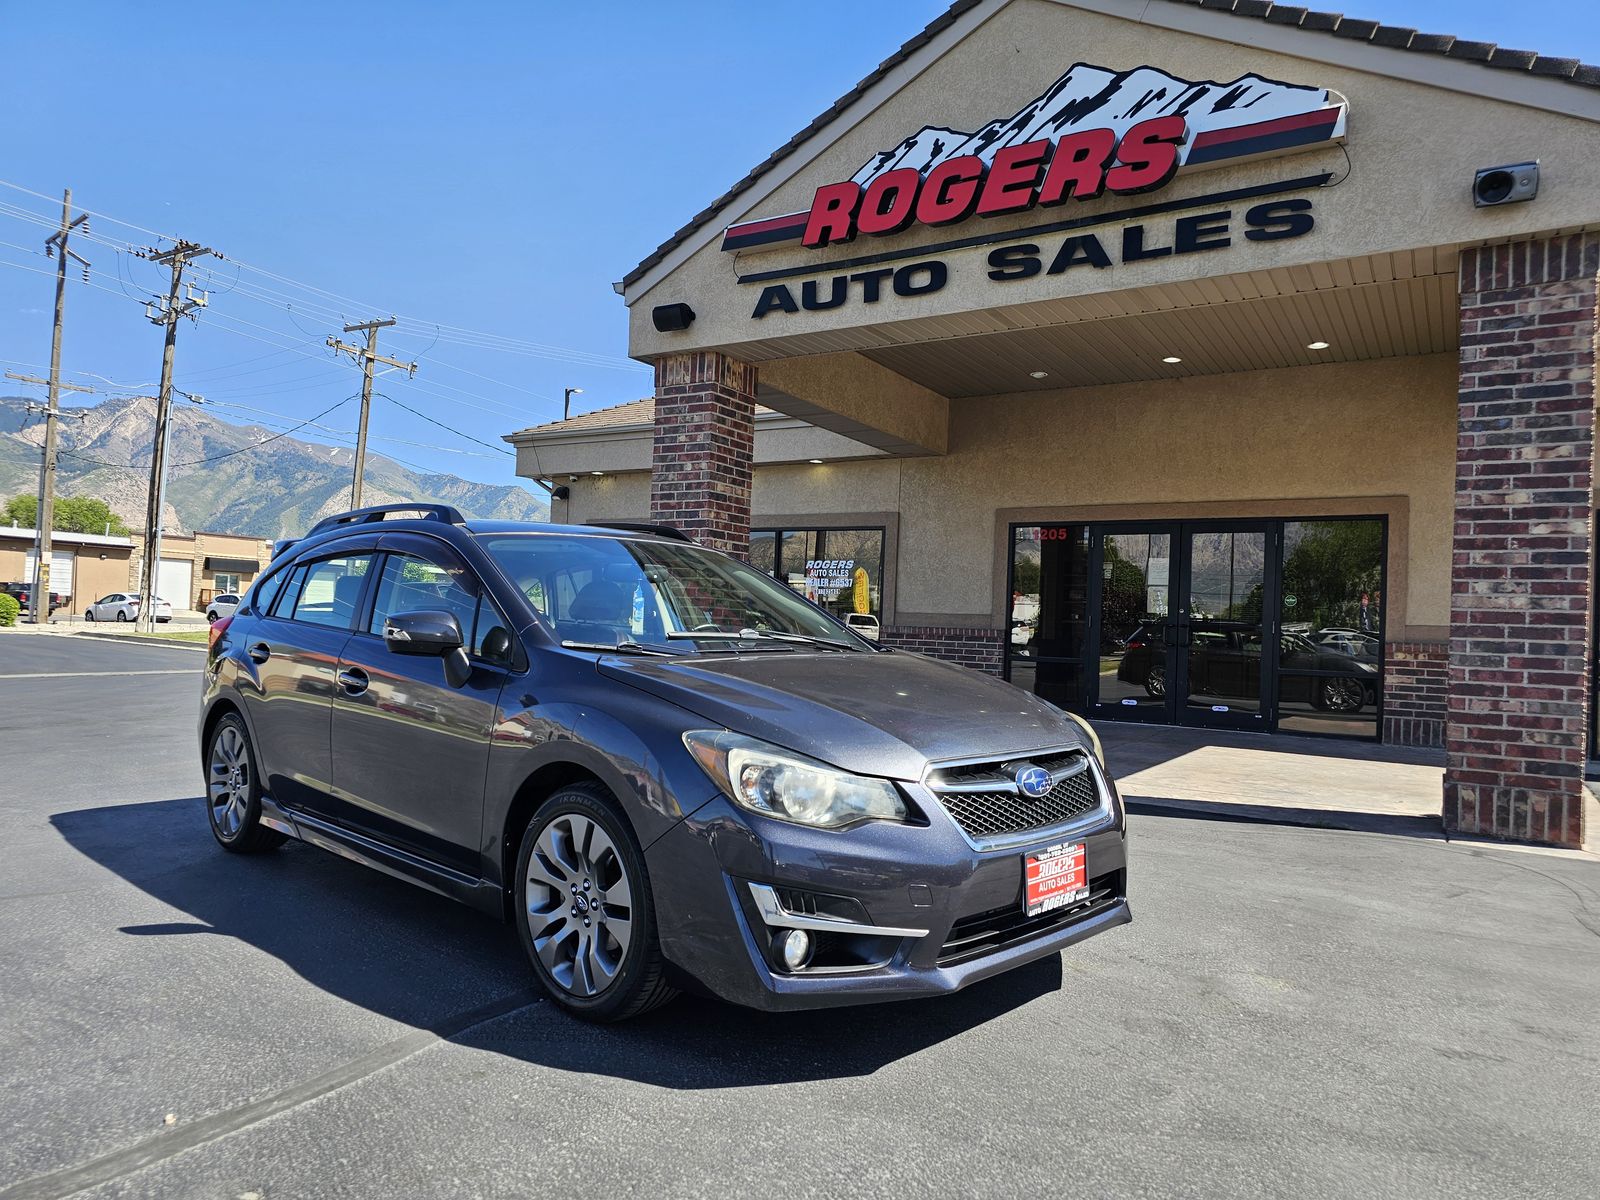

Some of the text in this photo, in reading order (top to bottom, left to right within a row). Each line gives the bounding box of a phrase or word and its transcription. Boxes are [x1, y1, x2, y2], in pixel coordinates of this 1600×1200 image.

[801, 115, 1190, 248] ROGERS
[751, 198, 1316, 319] AUTO SALES
[1033, 528, 1067, 540] 1205
[806, 560, 854, 569] ROGERS
[810, 569, 849, 577] AUTO SALES
[806, 578, 829, 587] DEALER
[1038, 857, 1075, 879] ROGERS
[1038, 880, 1057, 893] AUTO
[1056, 873, 1075, 887] SALES
[1042, 891, 1077, 912] ROGERS
